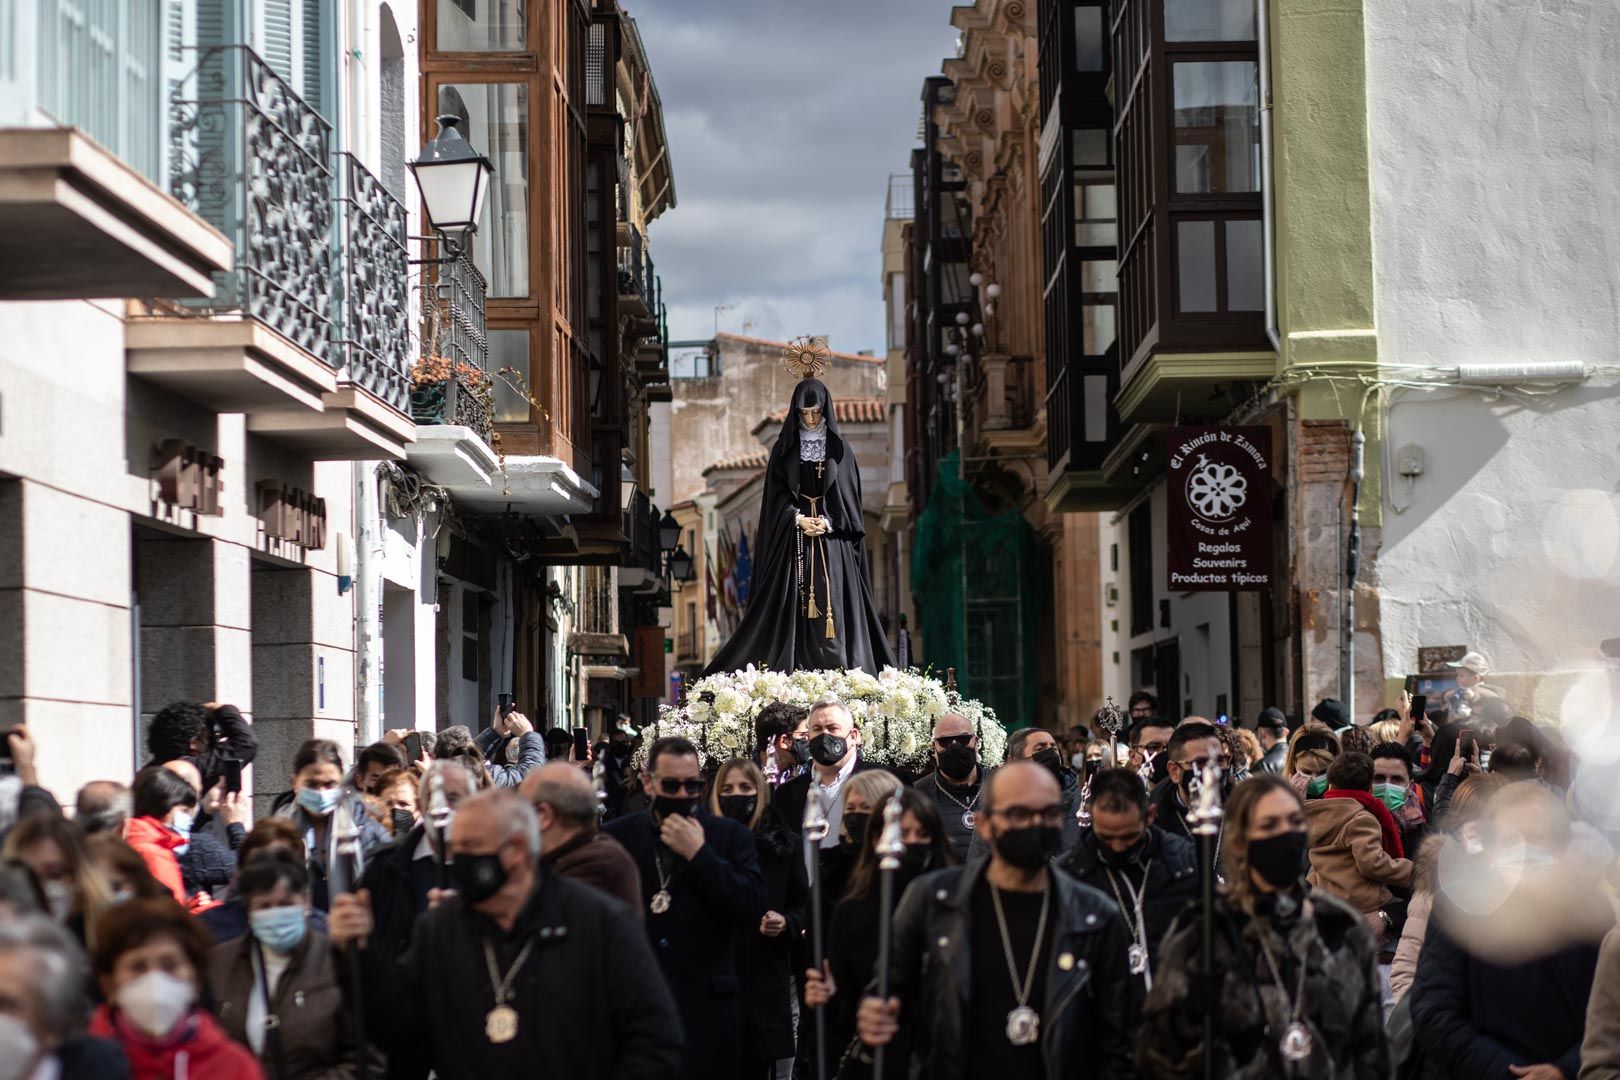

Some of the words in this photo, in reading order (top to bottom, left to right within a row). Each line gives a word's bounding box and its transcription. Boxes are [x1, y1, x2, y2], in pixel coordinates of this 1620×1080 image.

[1171, 453, 1184, 469] El
[1180, 431, 1217, 456] Rincón
[1220, 430, 1232, 442] de
[1234, 434, 1267, 470] Zamora
[1190, 518, 1215, 535] Cosas
[1218, 527, 1230, 536] de
[1233, 516, 1252, 533] Aquí
[1198, 541, 1242, 556] Regalos
[1192, 557, 1248, 568] Souvenirs
[1171, 571, 1227, 584] Productos
[1231, 571, 1268, 586] típicos
